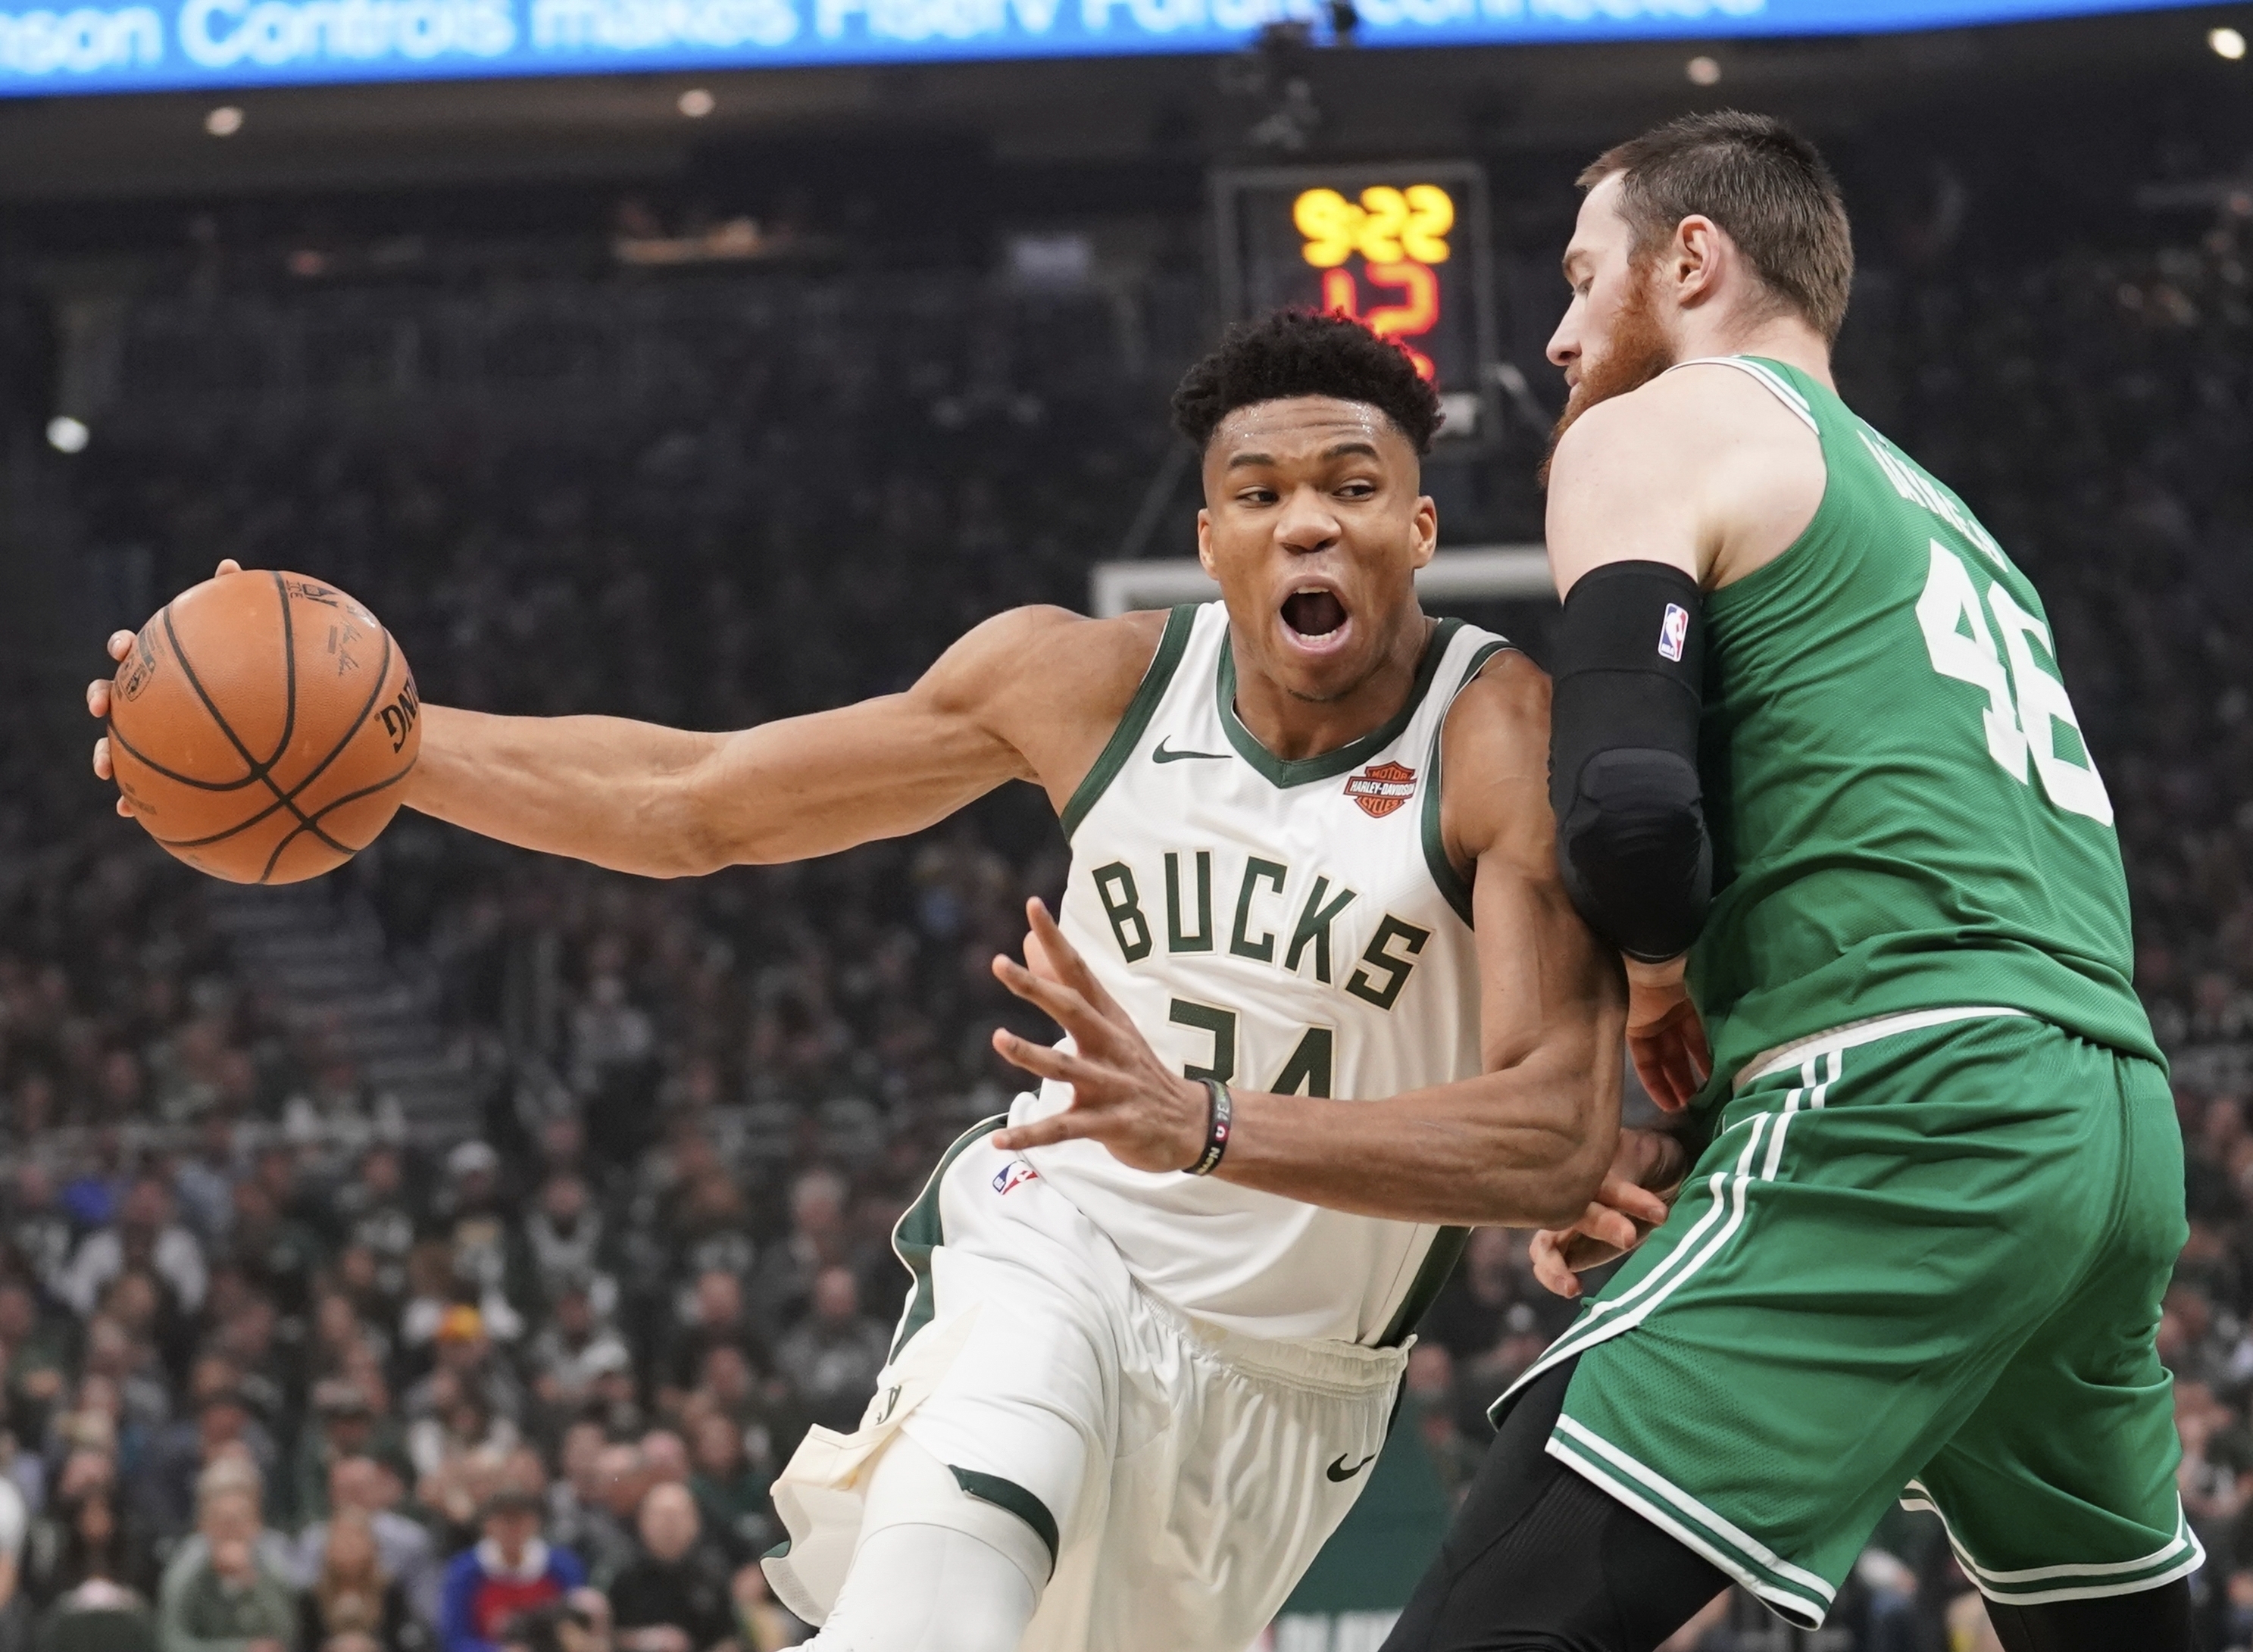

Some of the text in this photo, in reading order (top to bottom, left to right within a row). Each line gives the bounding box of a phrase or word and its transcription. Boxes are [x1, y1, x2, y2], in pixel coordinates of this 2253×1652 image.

[1915, 537, 2114, 828] 46
[1350, 780, 1416, 796] HARLEY-DAVIDSON
[1362, 797, 1398, 814] CYCLES
[1090, 847, 1436, 1013] BUCKS
